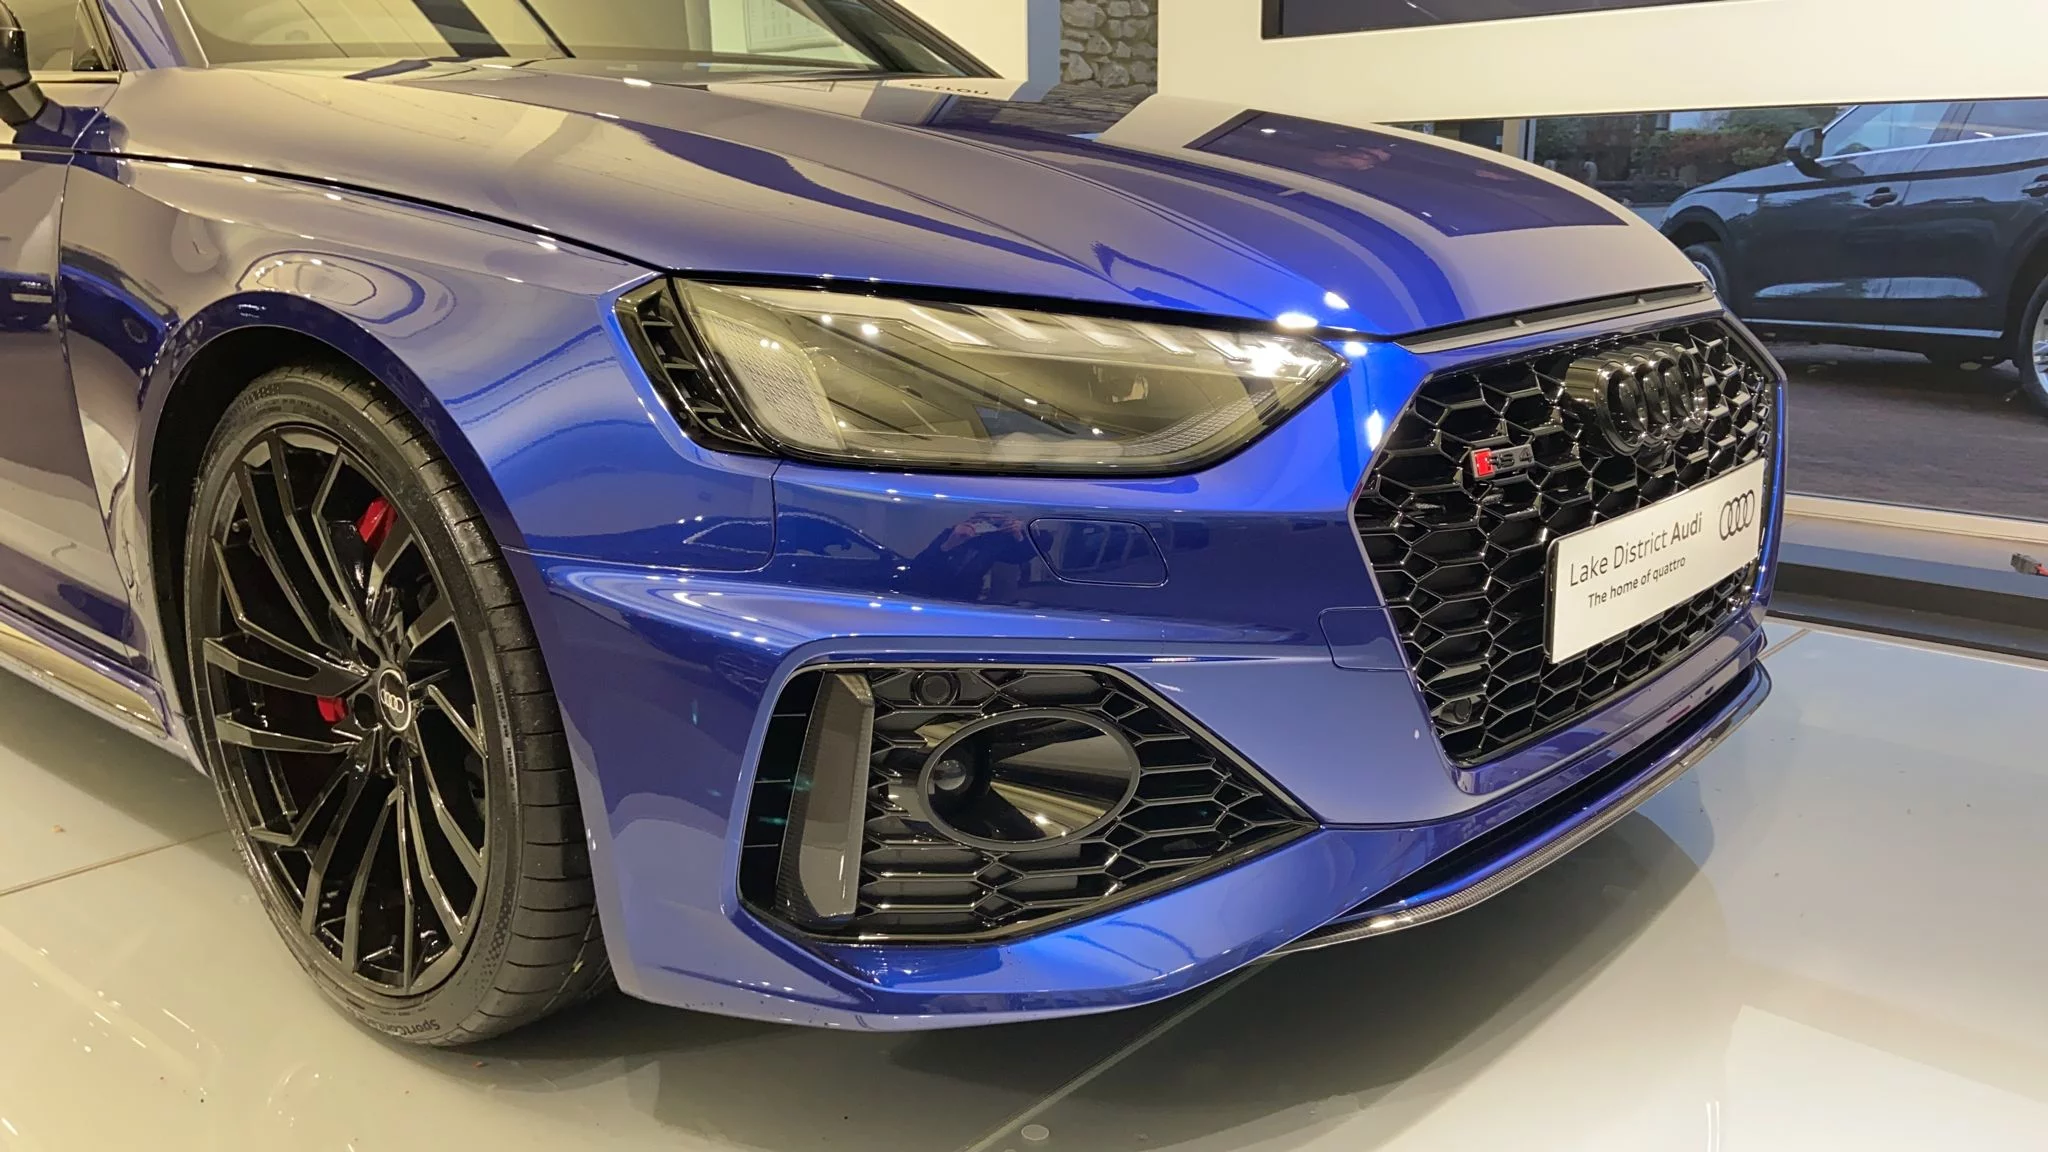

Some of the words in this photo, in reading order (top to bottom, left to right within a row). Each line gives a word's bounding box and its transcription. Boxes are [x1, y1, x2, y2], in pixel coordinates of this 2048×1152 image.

[1570, 556, 1608, 587] Lake
[1613, 530, 1667, 569] District
[1670, 512, 1702, 545] Audi
[1588, 592, 1607, 608] The
[1610, 578, 1638, 599] home
[1641, 569, 1651, 585] of
[1653, 557, 1685, 582] quattro
